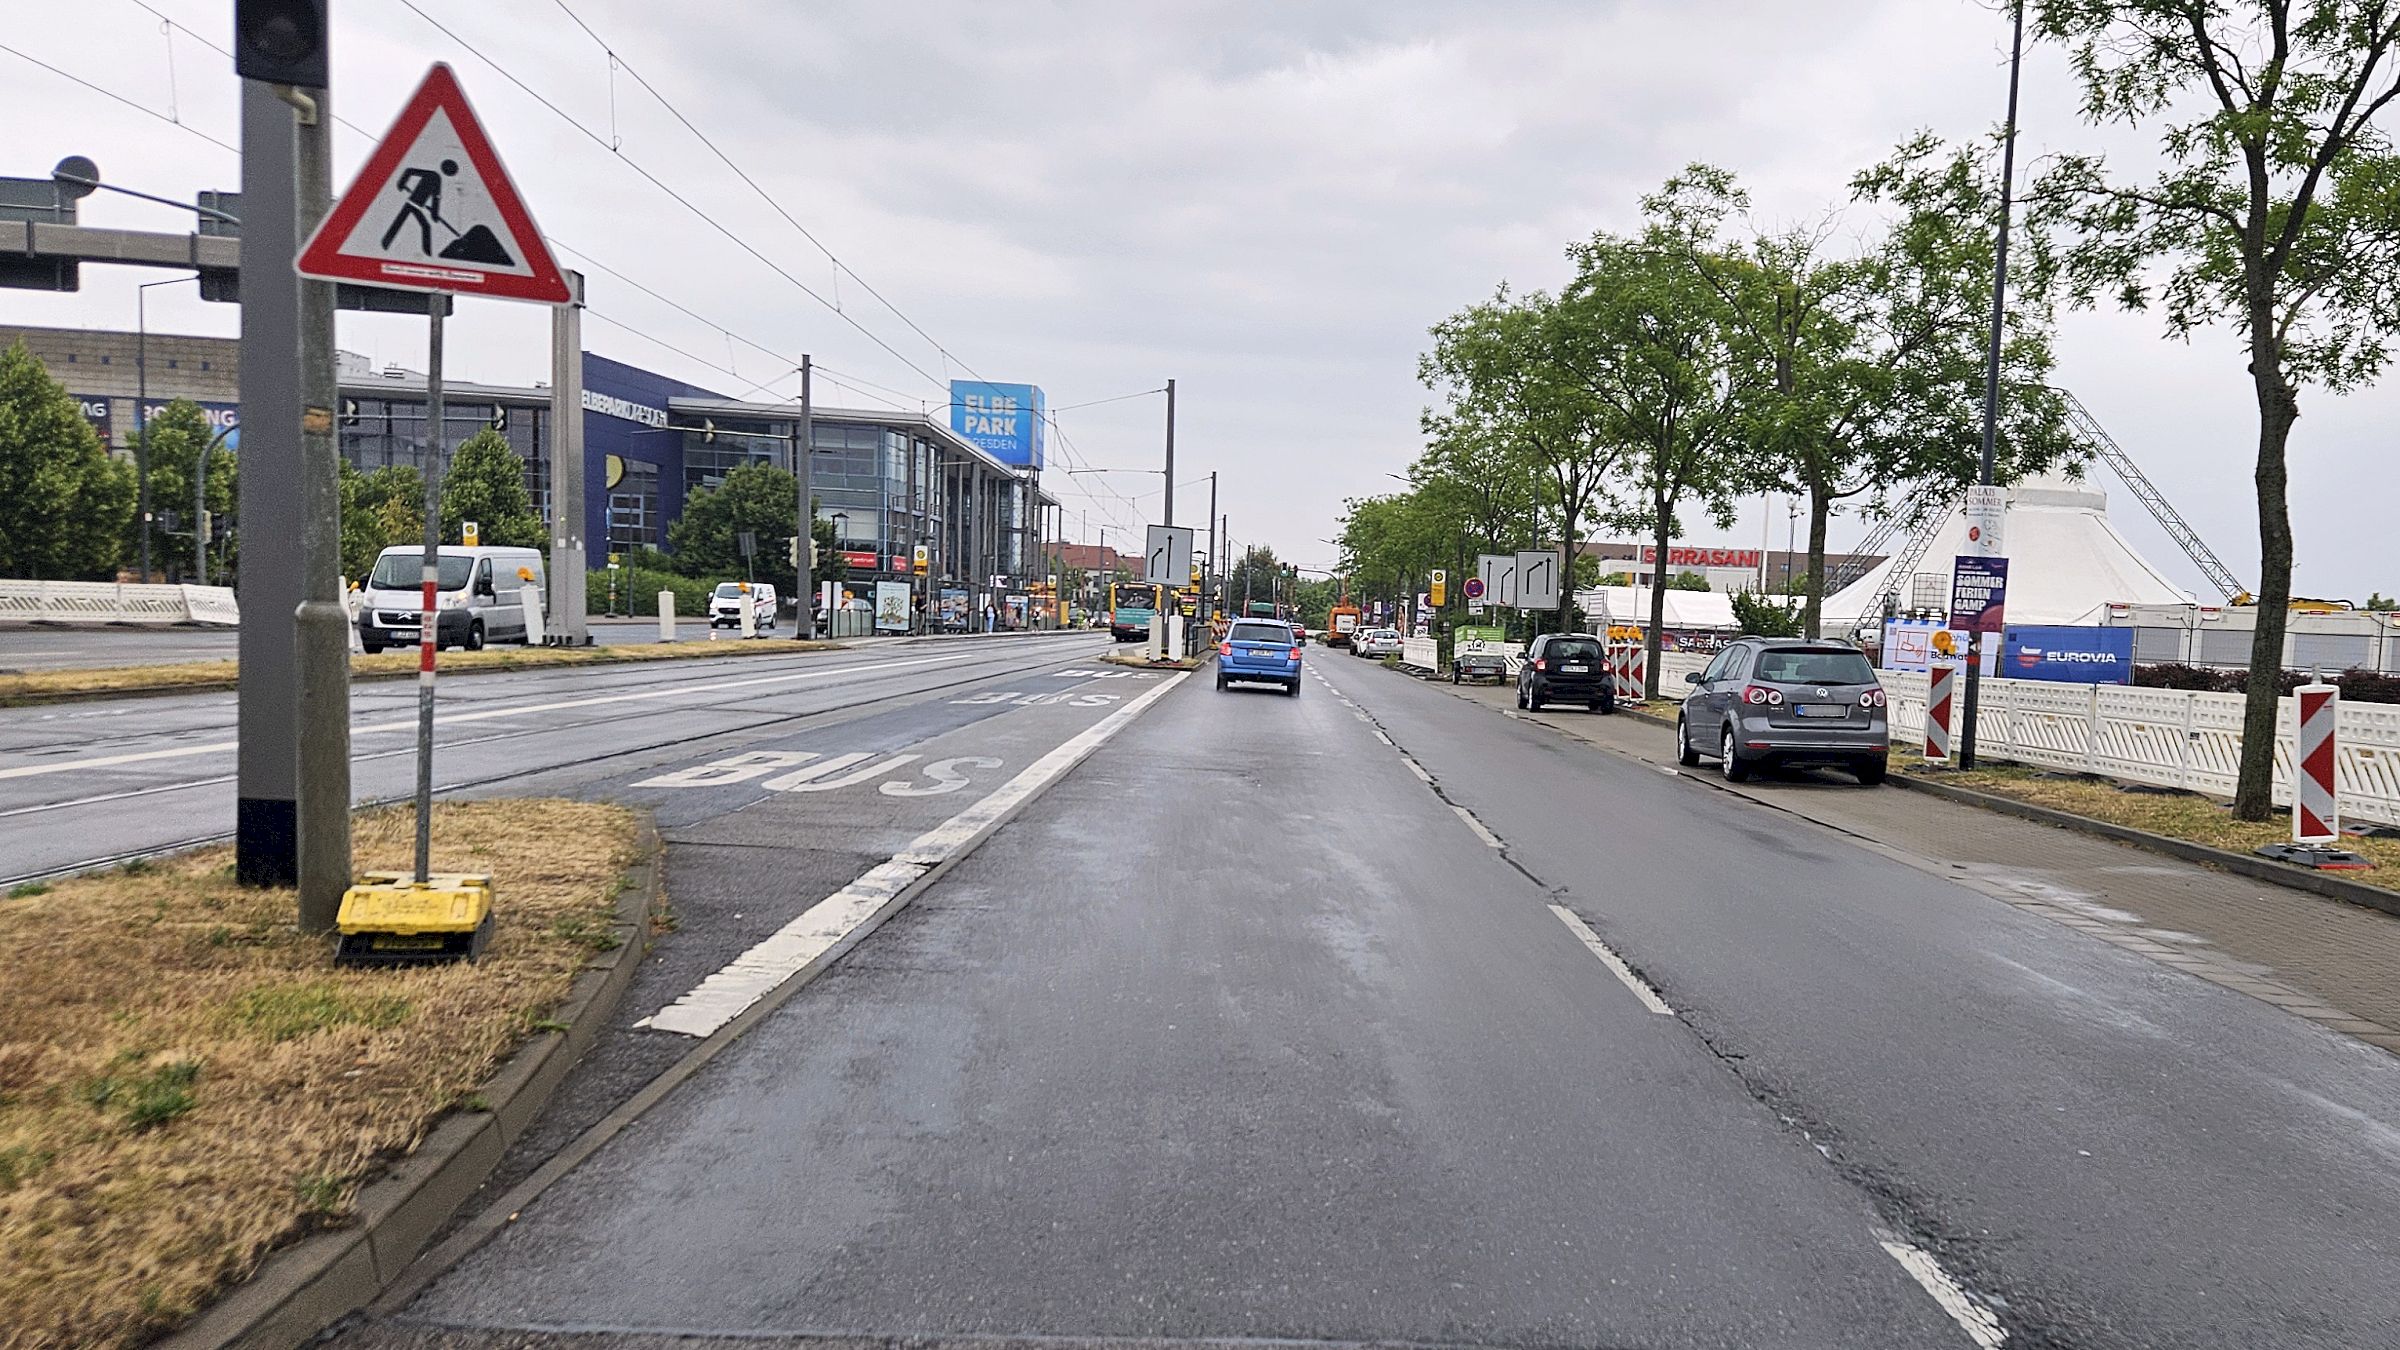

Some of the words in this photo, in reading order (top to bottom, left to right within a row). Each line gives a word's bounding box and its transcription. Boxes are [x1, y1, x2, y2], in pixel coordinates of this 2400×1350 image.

[964, 394, 1017, 415] ELBE
[964, 415, 1017, 436] PARK
[964, 437, 1017, 450] RESDEN
[1968, 496, 2001, 507] SOMMER
[1643, 547, 1760, 568] SRRASANI
[1956, 574, 2004, 588] SOMMER
[1955, 587, 1991, 600] FERIEN
[1954, 598, 1987, 612] CAMP
[2046, 651, 2117, 664] EUROVIA
[948, 692, 1122, 707] BUS
[628, 750, 1004, 797] BUS
